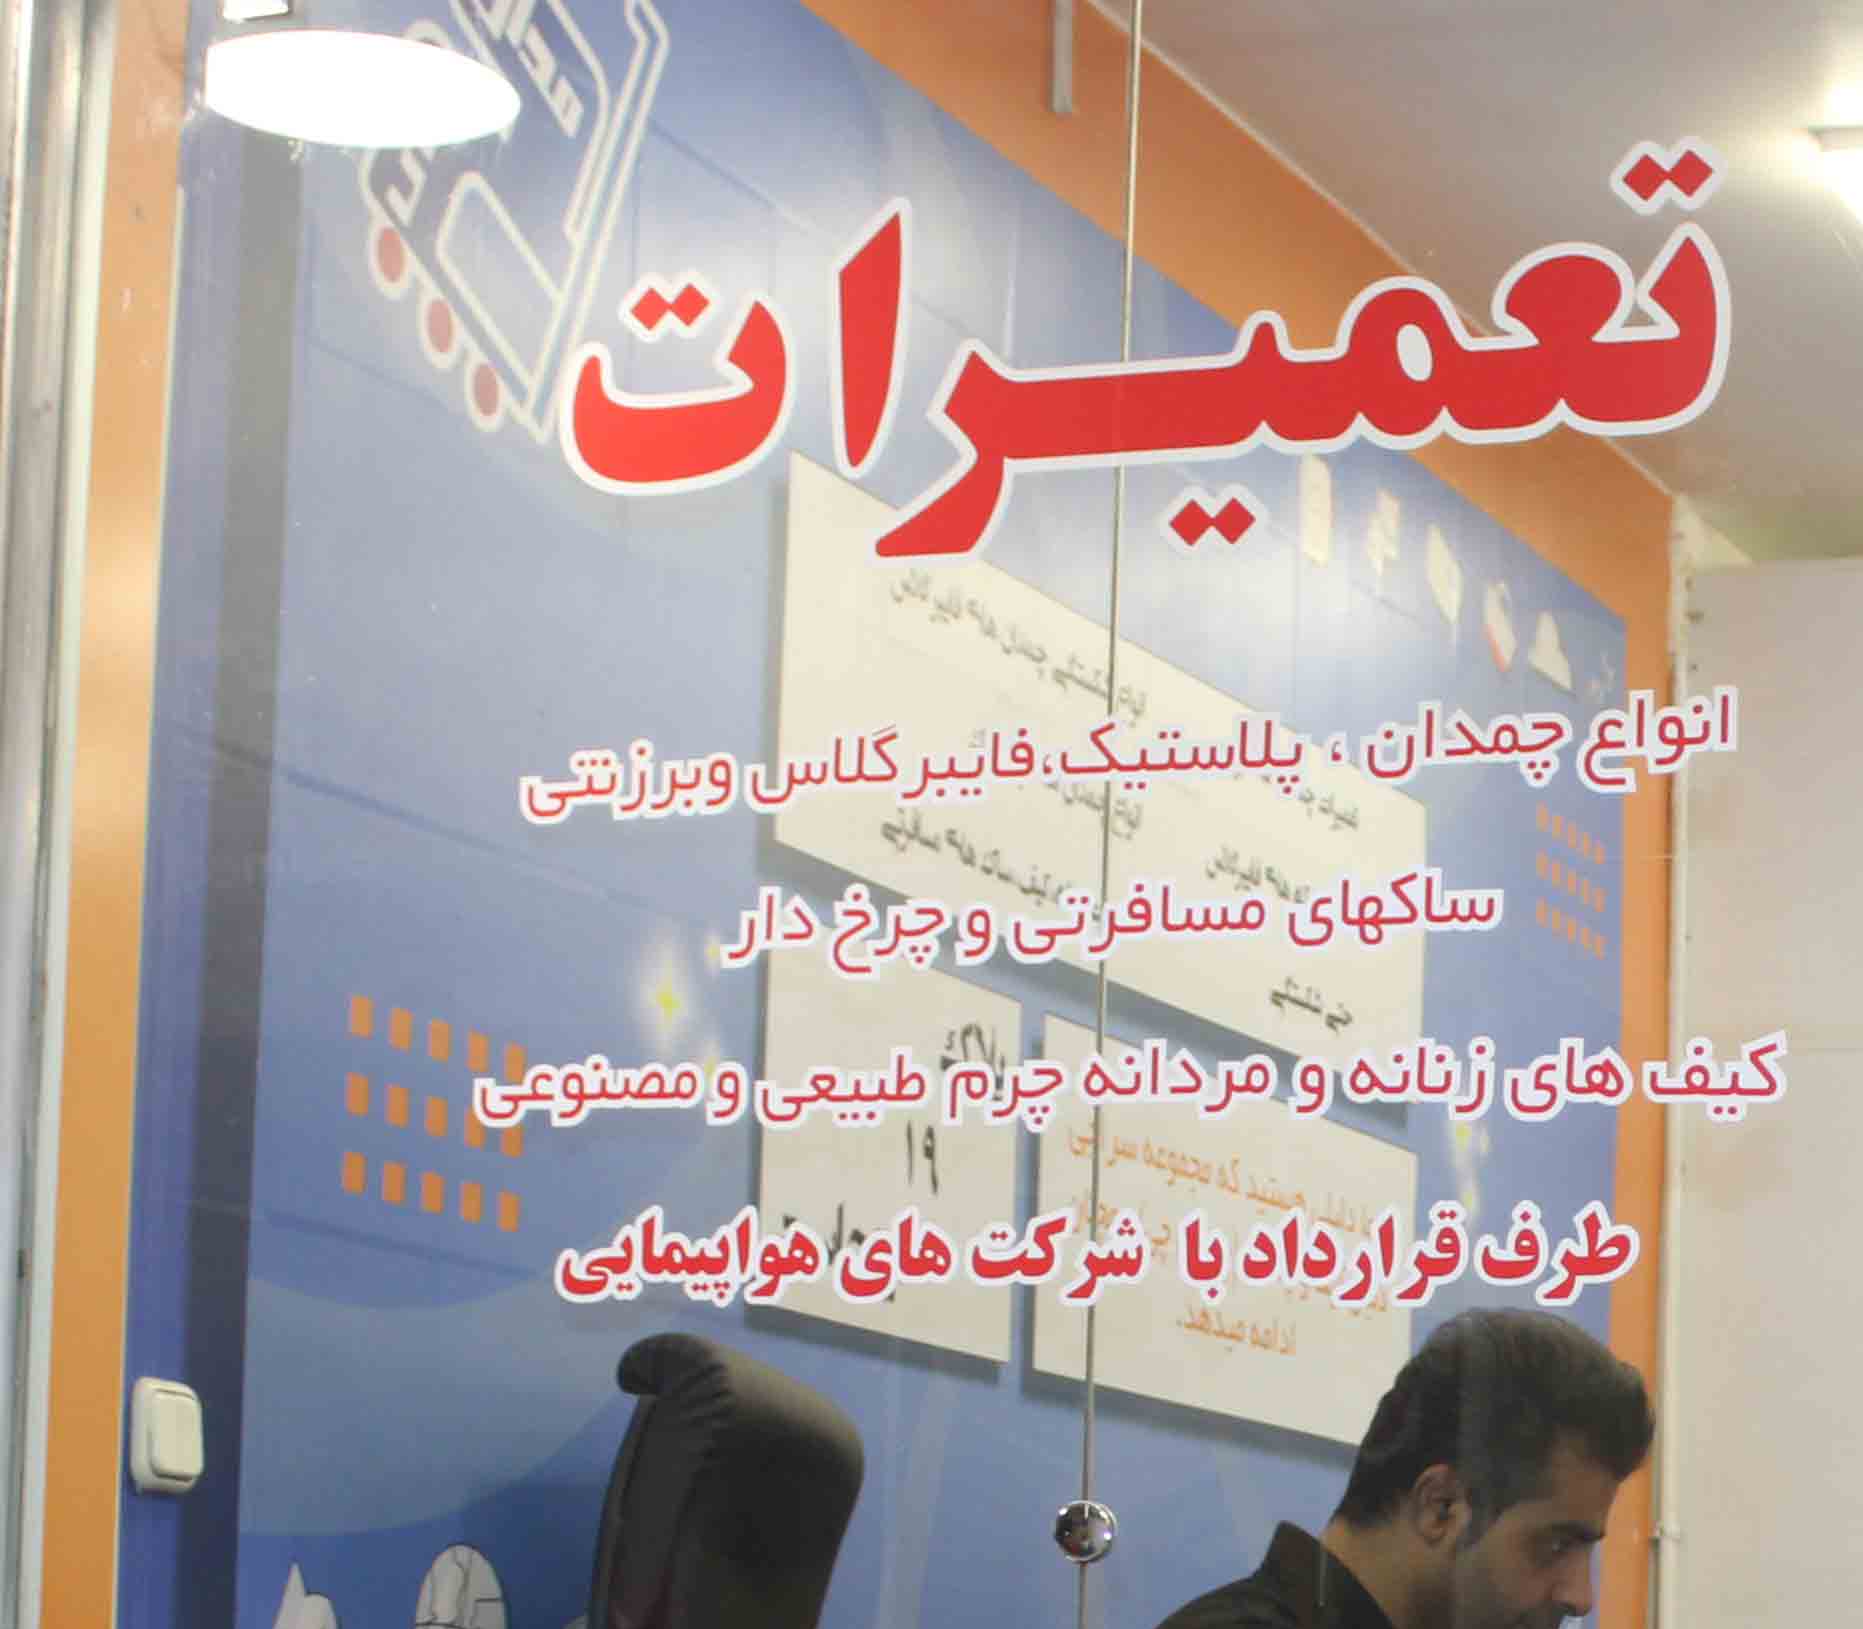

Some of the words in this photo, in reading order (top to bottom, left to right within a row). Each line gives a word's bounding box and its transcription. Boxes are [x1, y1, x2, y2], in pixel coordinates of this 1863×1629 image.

[568, 147, 1719, 560] تعمیرات
[1367, 708, 1567, 781] چمدان
[1582, 693, 1731, 786] انواع
[728, 893, 816, 961] دار
[833, 892, 946, 974] چرخ
[1012, 883, 1267, 957] مسافرتی
[1289, 871, 1497, 947] ساکهای
[481, 1063, 699, 1122] مصنوعی
[714, 1070, 742, 1121] و
[762, 1054, 926, 1123] طبیعی
[949, 1067, 1065, 1126] چرم
[1082, 1049, 1270, 1115] مردانه
[1295, 1062, 1326, 1115] و
[1347, 1044, 1487, 1115] زنانه
[1510, 1049, 1626, 1115] های
[1649, 1042, 1779, 1115] کیف
[560, 1217, 822, 1301] هواپیمایی
[840, 1216, 953, 1299] های
[971, 1217, 1145, 1301] شرکت
[1185, 1219, 1225, 1298] با
[1242, 1209, 1462, 1302] قرارداد
[1480, 1209, 1633, 1301] طرف
